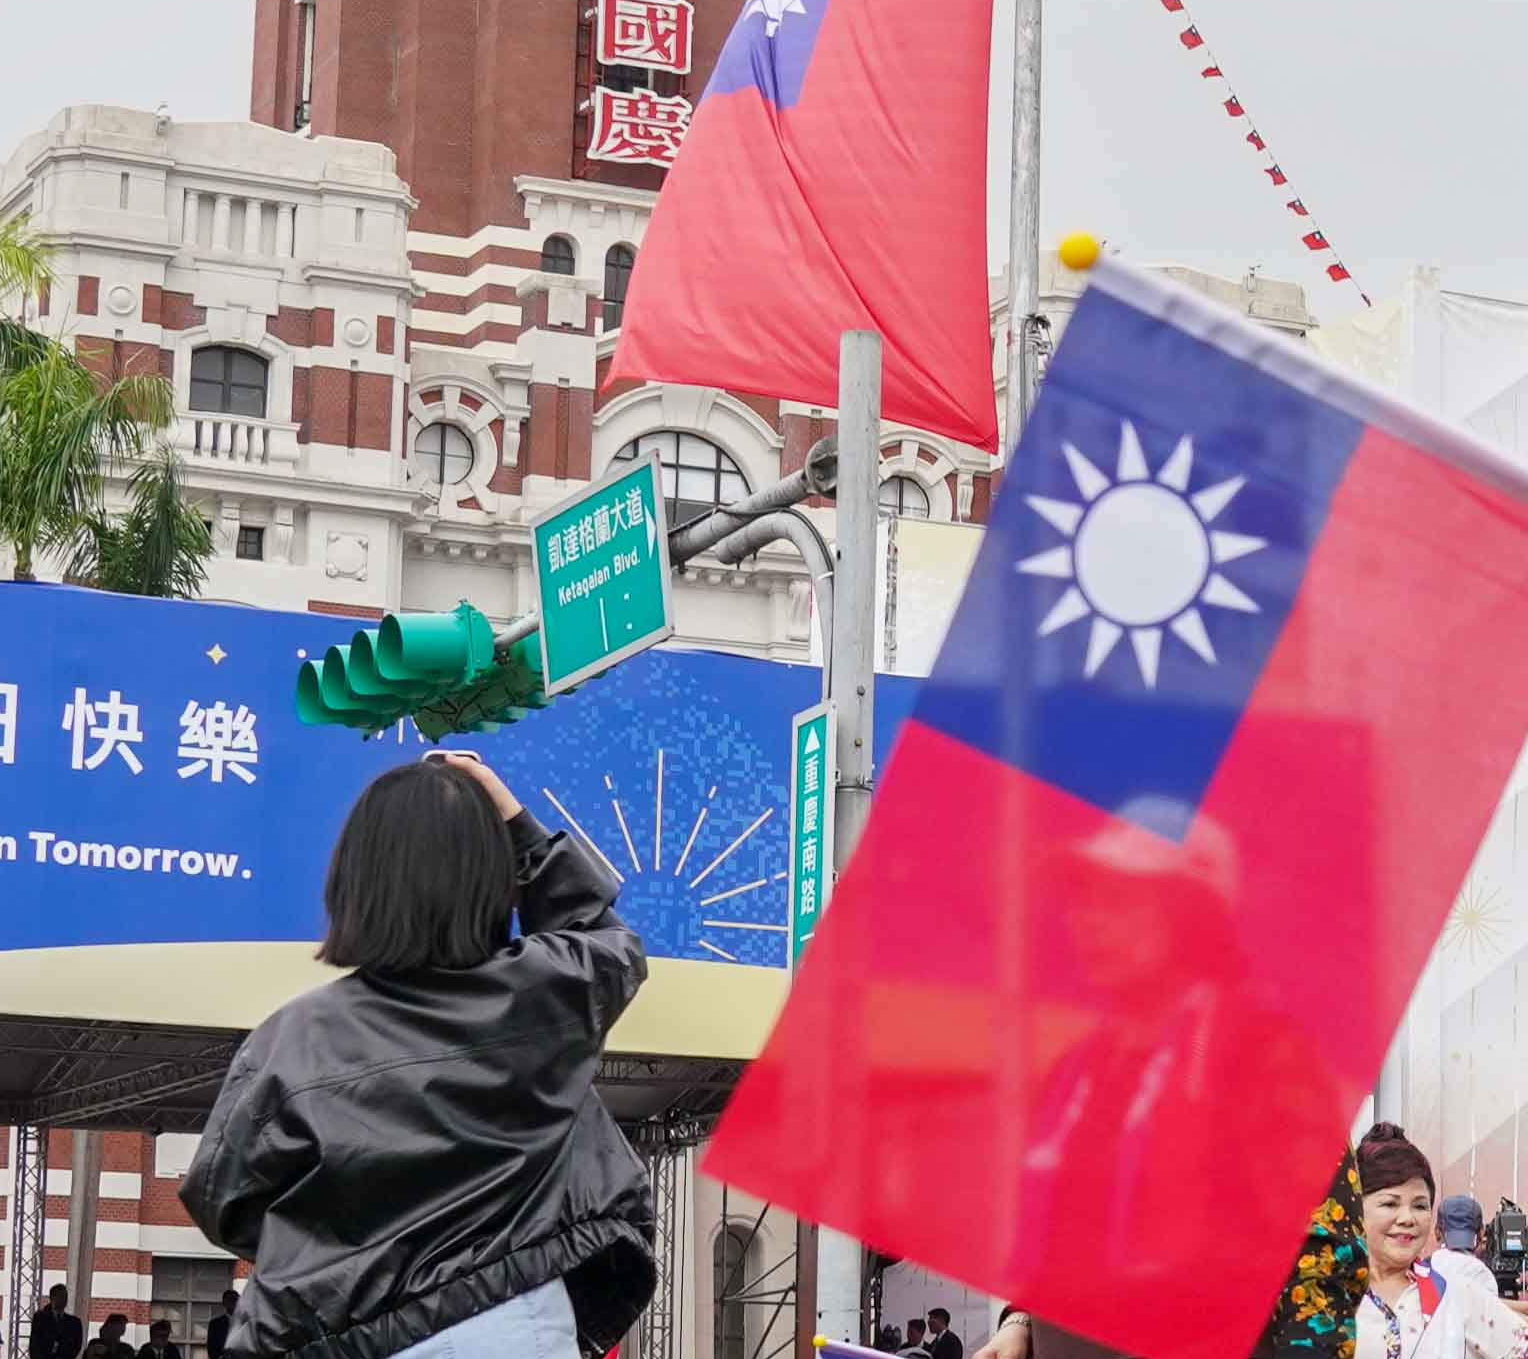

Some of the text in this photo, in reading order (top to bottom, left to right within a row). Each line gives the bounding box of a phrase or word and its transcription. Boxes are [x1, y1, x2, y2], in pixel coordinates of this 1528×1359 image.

[548, 485, 644, 573] 凱達格蘭大道
[558, 545, 640, 606] Ketagalan Blvd.
[29, 831, 253, 878] Tomorrow.
